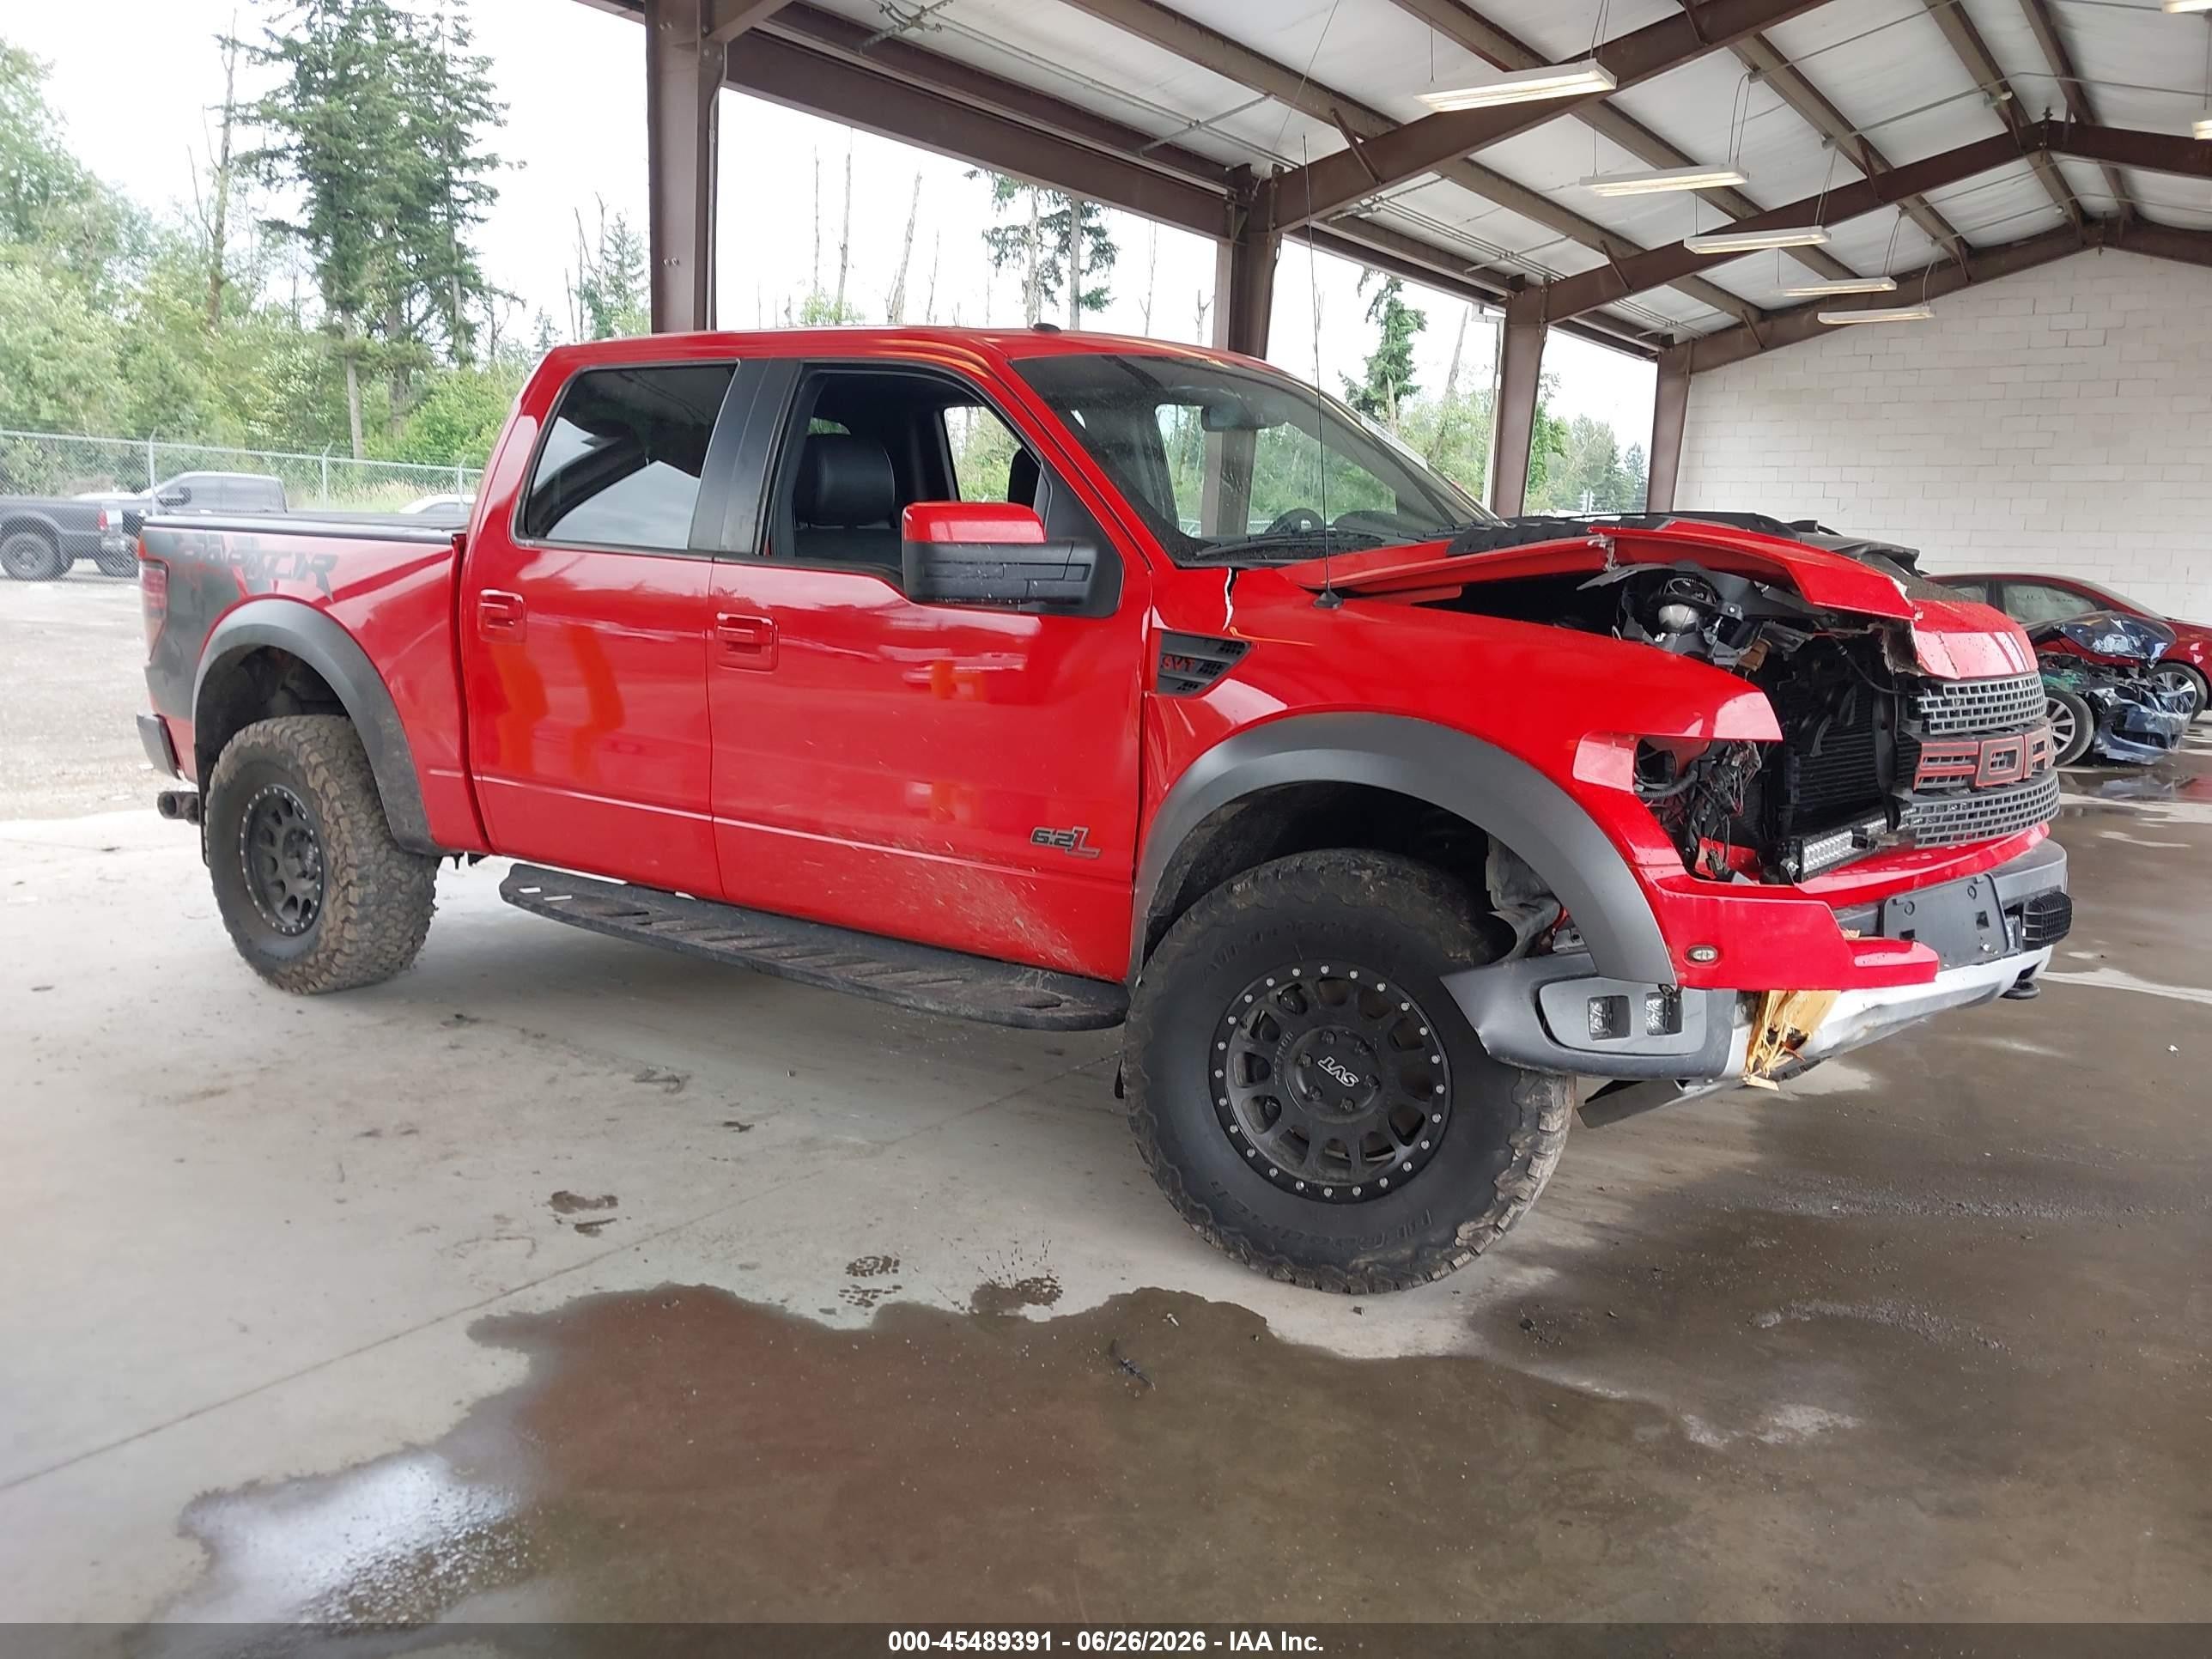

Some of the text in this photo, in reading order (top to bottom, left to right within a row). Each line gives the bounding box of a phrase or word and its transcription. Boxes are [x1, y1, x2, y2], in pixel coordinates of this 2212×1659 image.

[1162, 653, 1198, 673] SVT
[1914, 726, 2056, 792] FOR
[1316, 1055, 1360, 1087] SVT
